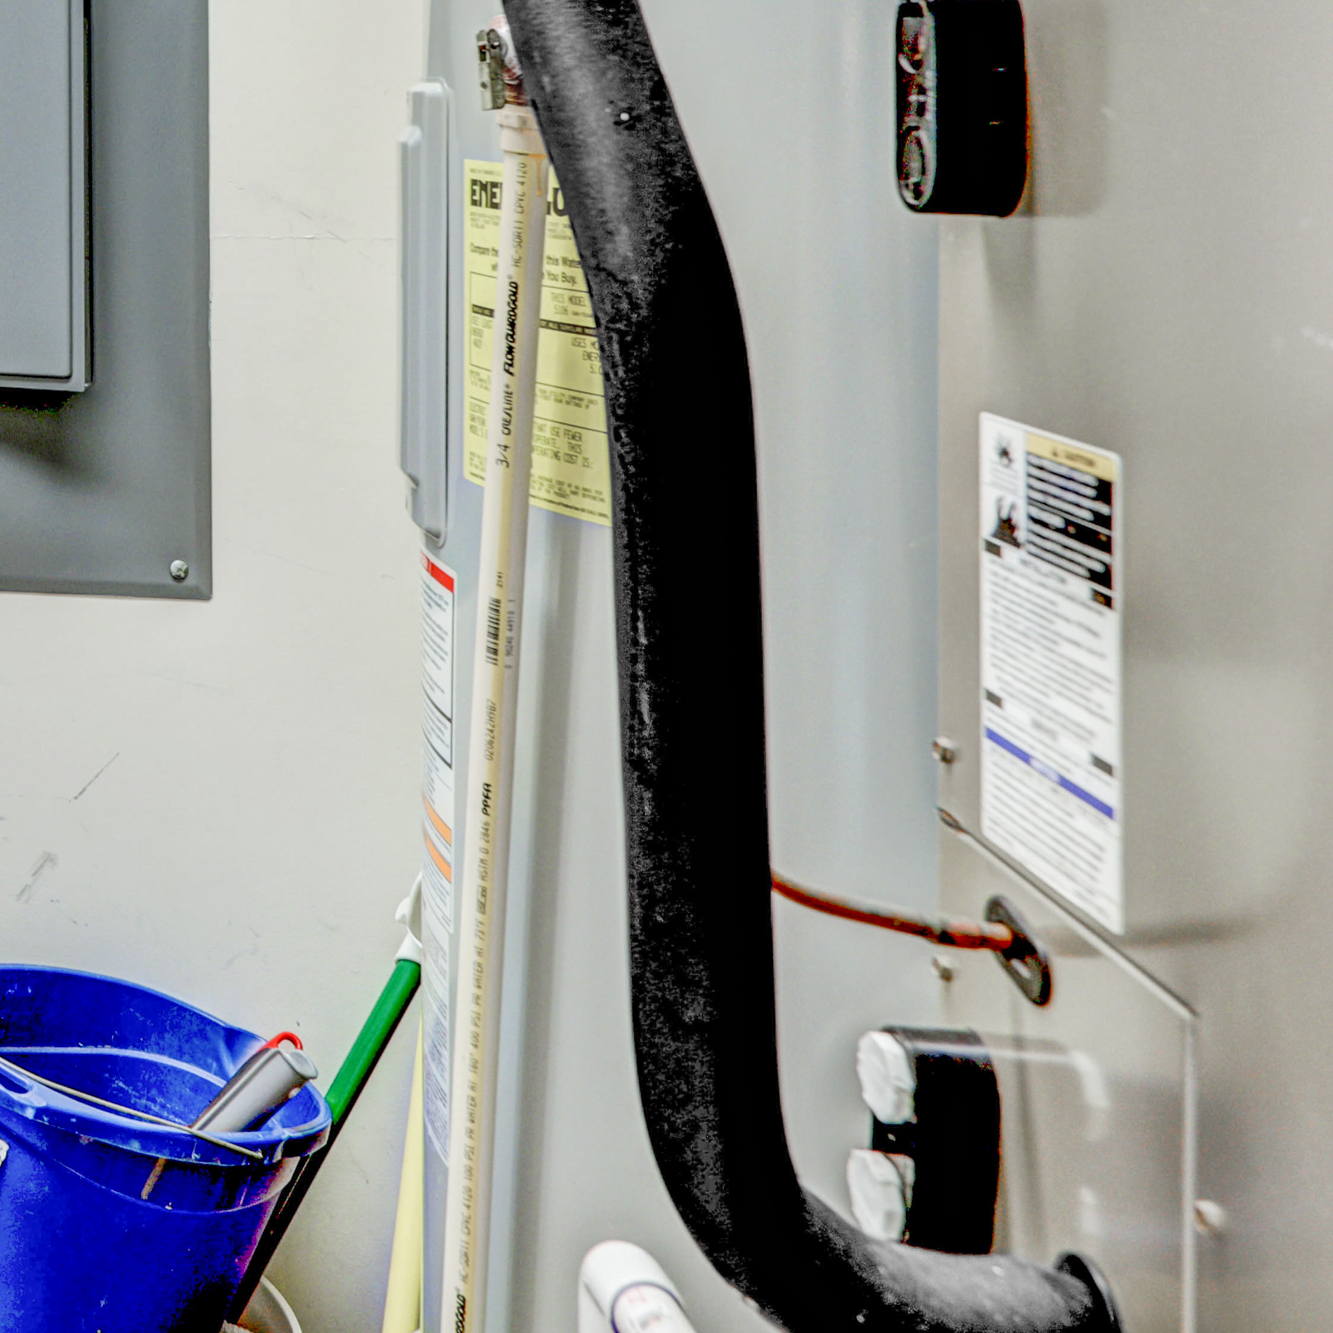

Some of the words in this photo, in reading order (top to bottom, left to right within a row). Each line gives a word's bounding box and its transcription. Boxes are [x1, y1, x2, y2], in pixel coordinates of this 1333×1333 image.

[517, 162, 527, 187] 4120
[515, 191, 526, 215] CPVC
[546, 256, 560, 266] this
[546, 270, 559, 282] You
[563, 428, 582, 442] FEWER
[496, 444, 511, 468] 3/4
[563, 452, 578, 464] COST
[481, 782, 492, 817] PPFA
[479, 821, 490, 843] 2846
[479, 858, 489, 882] ASTM
[474, 946, 484, 958] AT
[473, 962, 484, 989] WATER
[472, 993, 482, 1007] PR
[471, 1010, 481, 1028] PSI
[470, 1029, 480, 1049] 400
[468, 1080, 478, 1092] AT
[466, 1094, 477, 1124] WATER
[464, 1127, 476, 1141] PR
[464, 1144, 475, 1161] PSI
[463, 1166, 473, 1182] 100
[462, 1186, 473, 1209] 4120
[460, 1212, 472, 1236] CPVC
